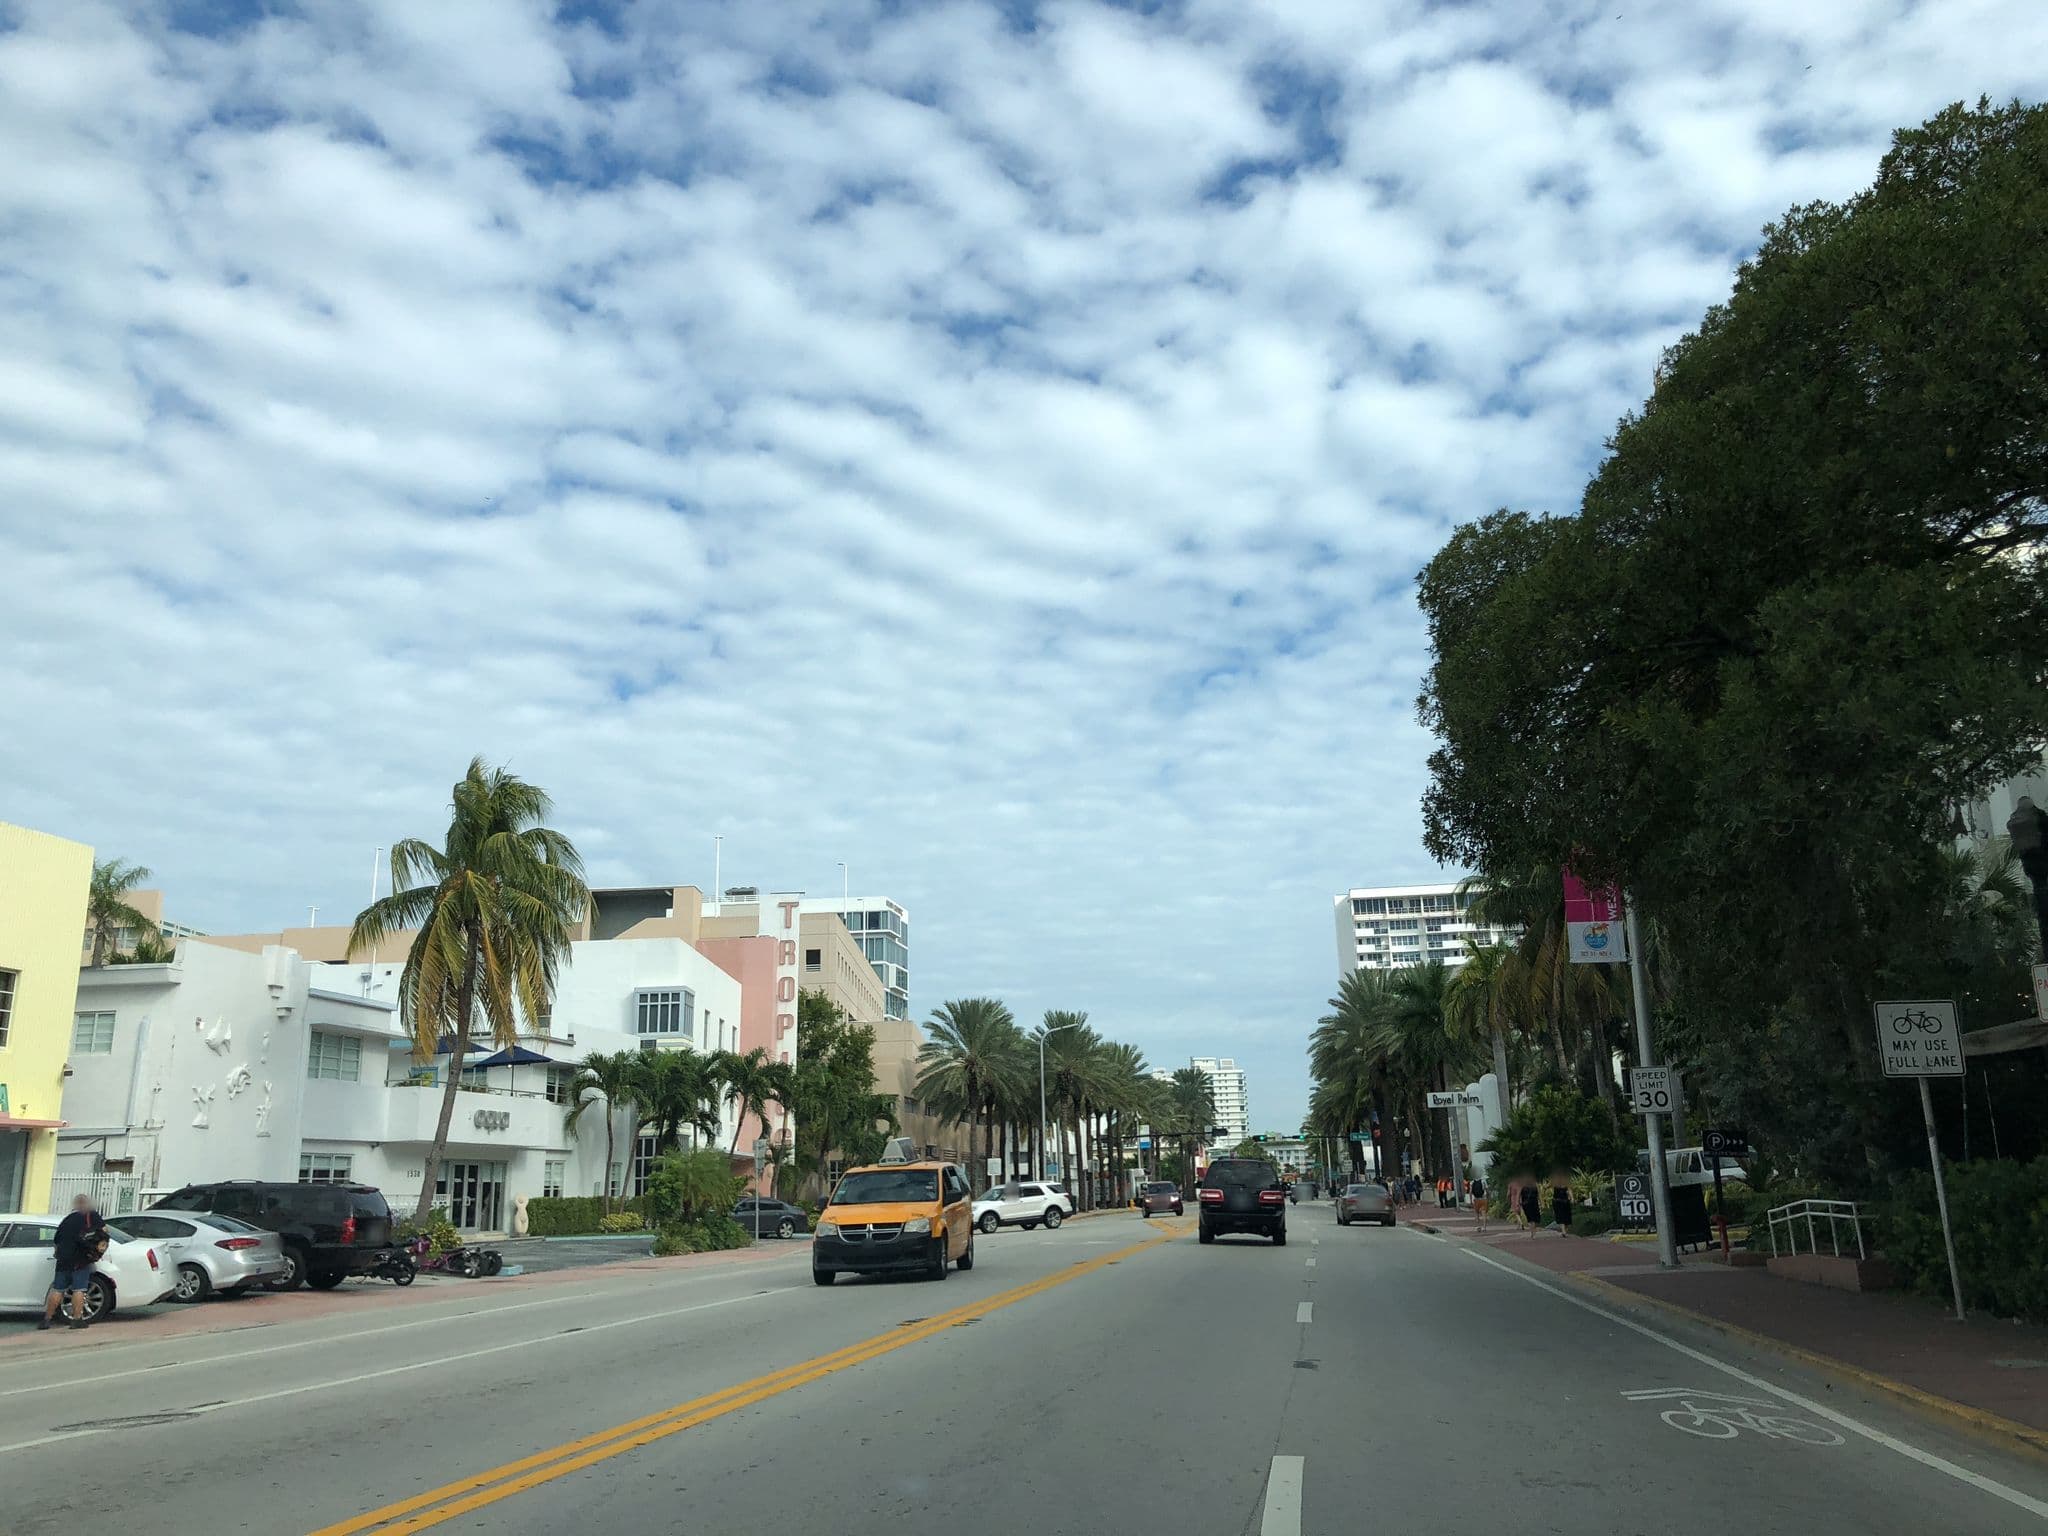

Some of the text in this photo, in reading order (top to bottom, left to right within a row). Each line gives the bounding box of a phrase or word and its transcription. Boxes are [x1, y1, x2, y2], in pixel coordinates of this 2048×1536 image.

[776, 901, 799, 1149] TROPS
[1893, 1040, 1949, 1052] MAY USE
[1888, 1055, 1958, 1069] FULL LANE
[1635, 1071, 1667, 1080] SPEED
[1639, 1081, 1664, 1090] LIMIT
[1432, 1093, 1480, 1105] Royal Palm
[1640, 1091, 1669, 1108] 30
